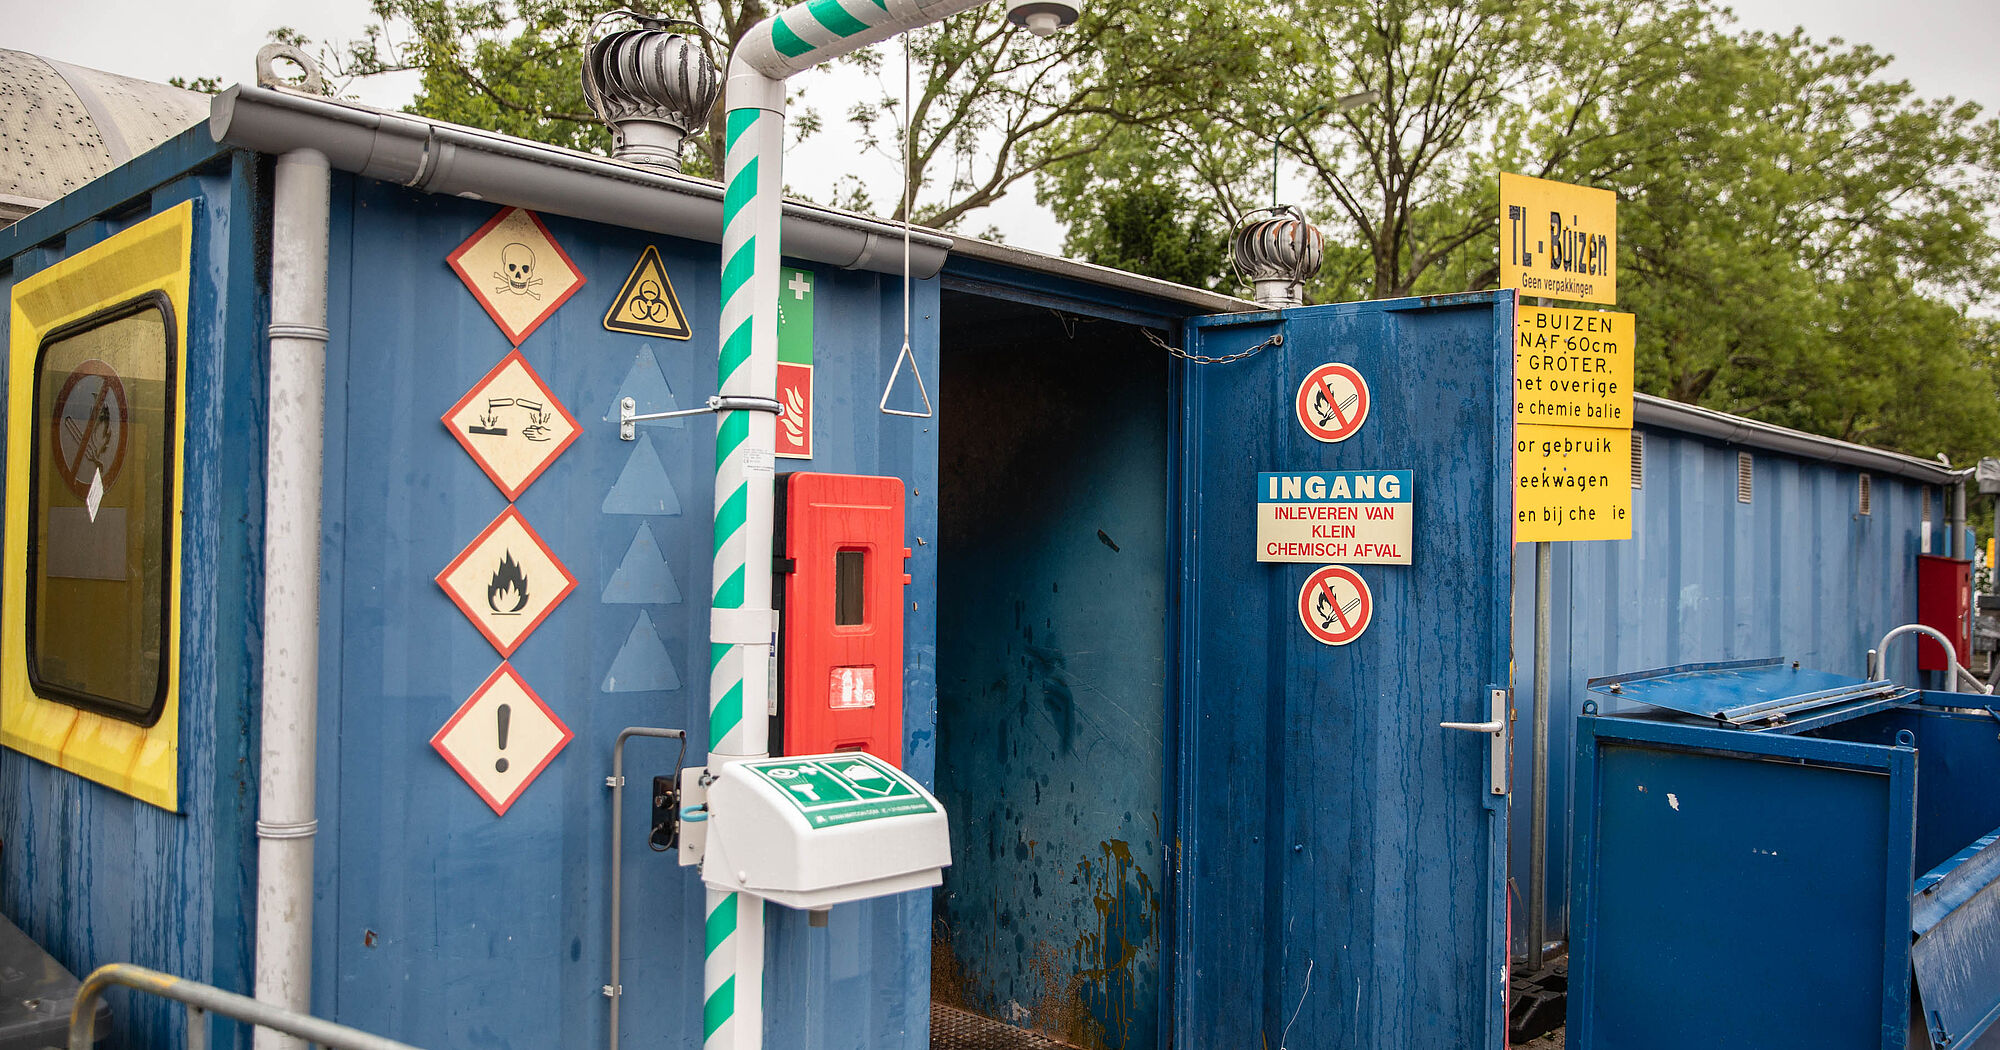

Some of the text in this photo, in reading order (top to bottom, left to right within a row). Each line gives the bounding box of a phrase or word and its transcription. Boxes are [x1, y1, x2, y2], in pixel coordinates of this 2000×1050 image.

[1508, 205, 1532, 267] TL
[1550, 211, 1607, 277] Buizen
[1522, 272, 1593, 298] Geen verpakkingen
[1517, 313, 1612, 333] -BUIZEN
[1520, 332, 1617, 354] NAF 60cm
[1529, 355, 1612, 374] GROTER.
[1550, 378, 1617, 397] overige
[1517, 400, 1621, 419] e chemie balie
[1518, 437, 1611, 457] or gebruik
[1269, 475, 1400, 499] INGANG
[1516, 472, 1608, 492] eekwagen
[1275, 507, 1394, 520] INLEVEREN VAN
[1518, 510, 1536, 522] en
[1543, 506, 1562, 526] bij
[1312, 525, 1355, 538] KLEIN
[1267, 542, 1401, 558] CHEMISCH AFVAL
